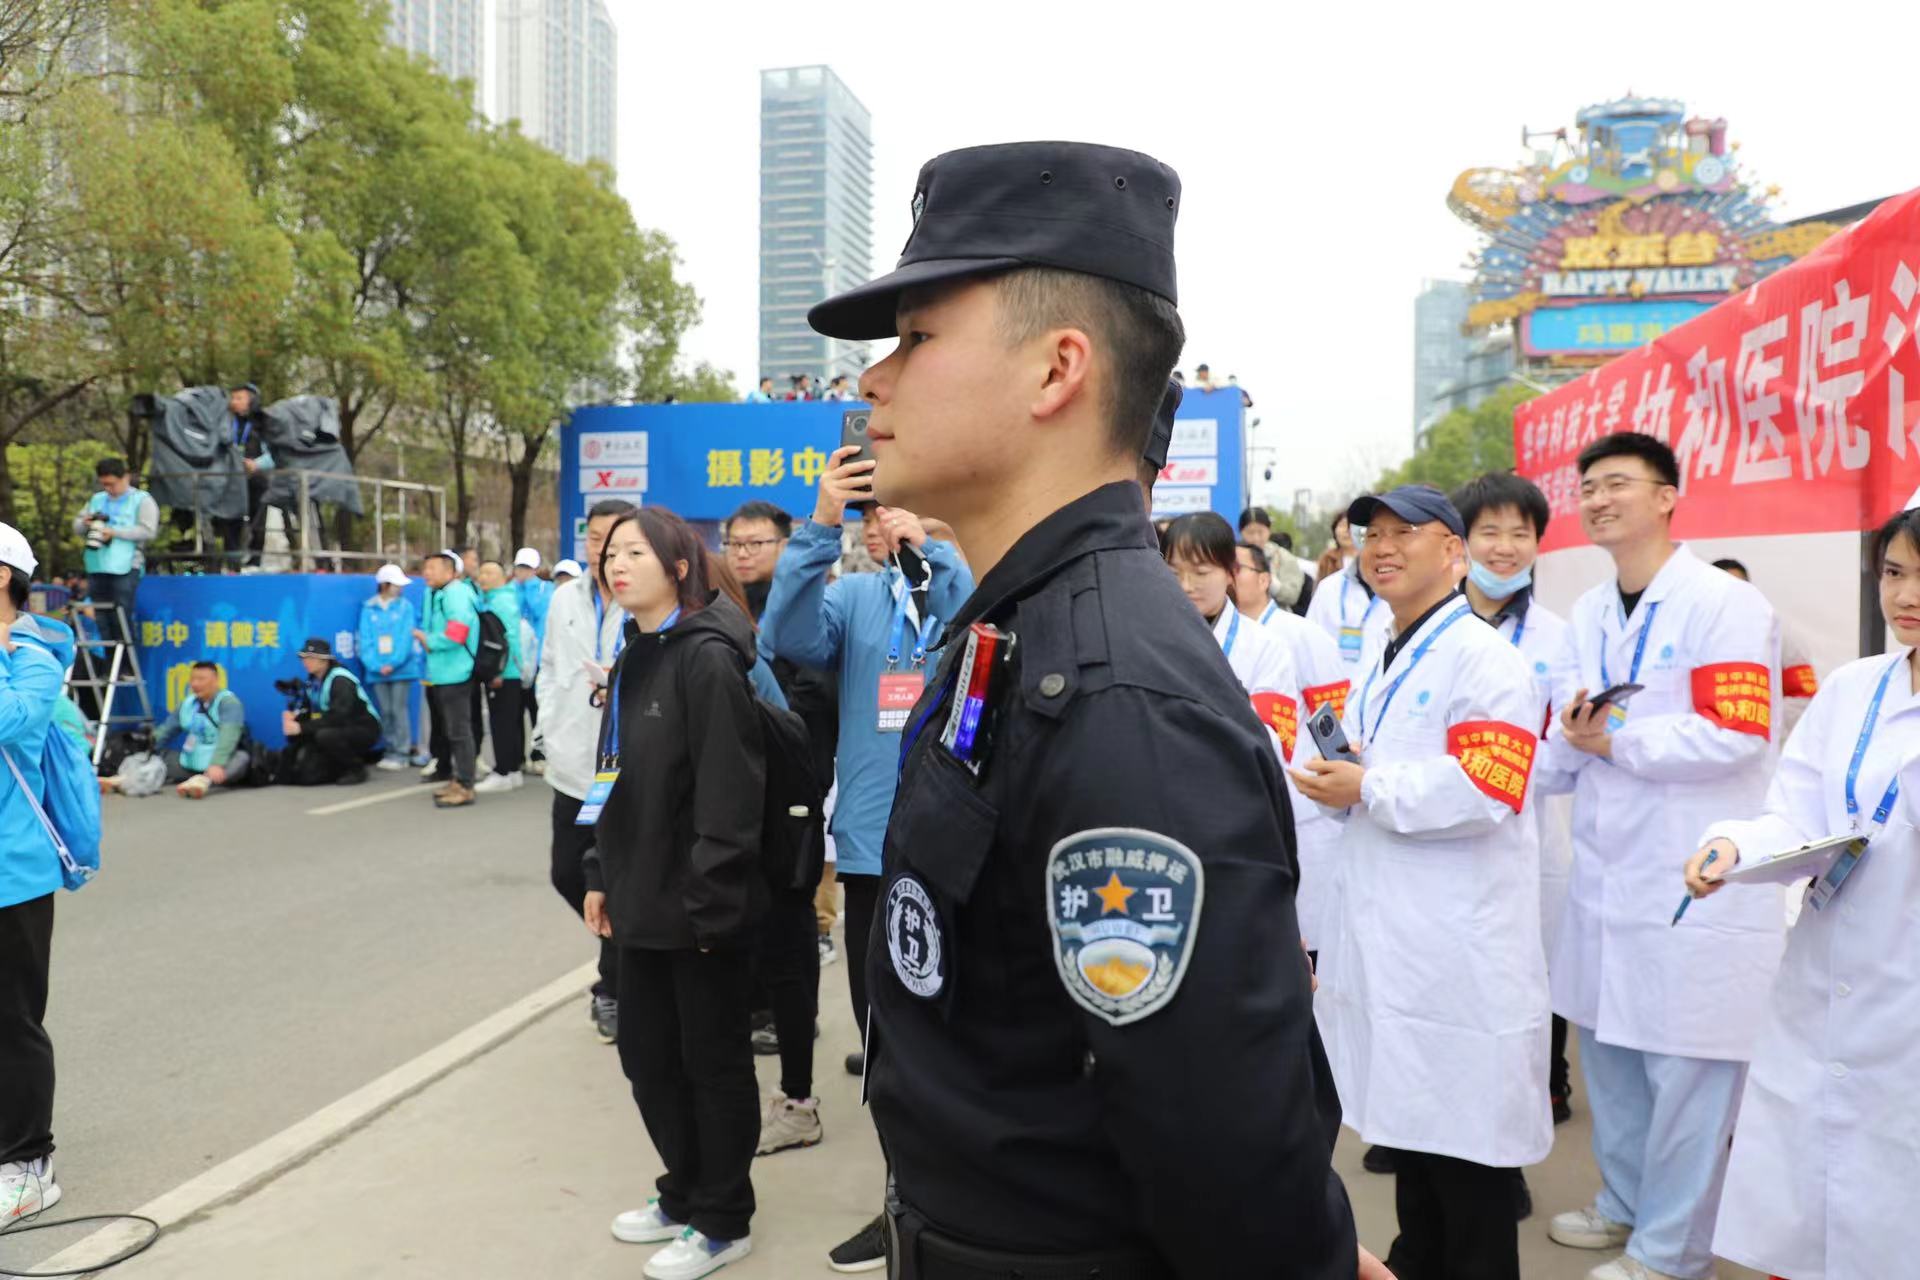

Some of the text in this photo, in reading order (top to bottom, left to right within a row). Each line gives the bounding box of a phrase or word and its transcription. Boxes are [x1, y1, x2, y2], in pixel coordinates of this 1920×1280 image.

[1542, 266, 1738, 296] HAPPY VALLEY
[707, 446, 826, 487] 摄影中
[205, 621, 280, 648] 请微笑
[1060, 884, 1176, 921] 护 卫
[903, 904, 921, 971] 护卫
